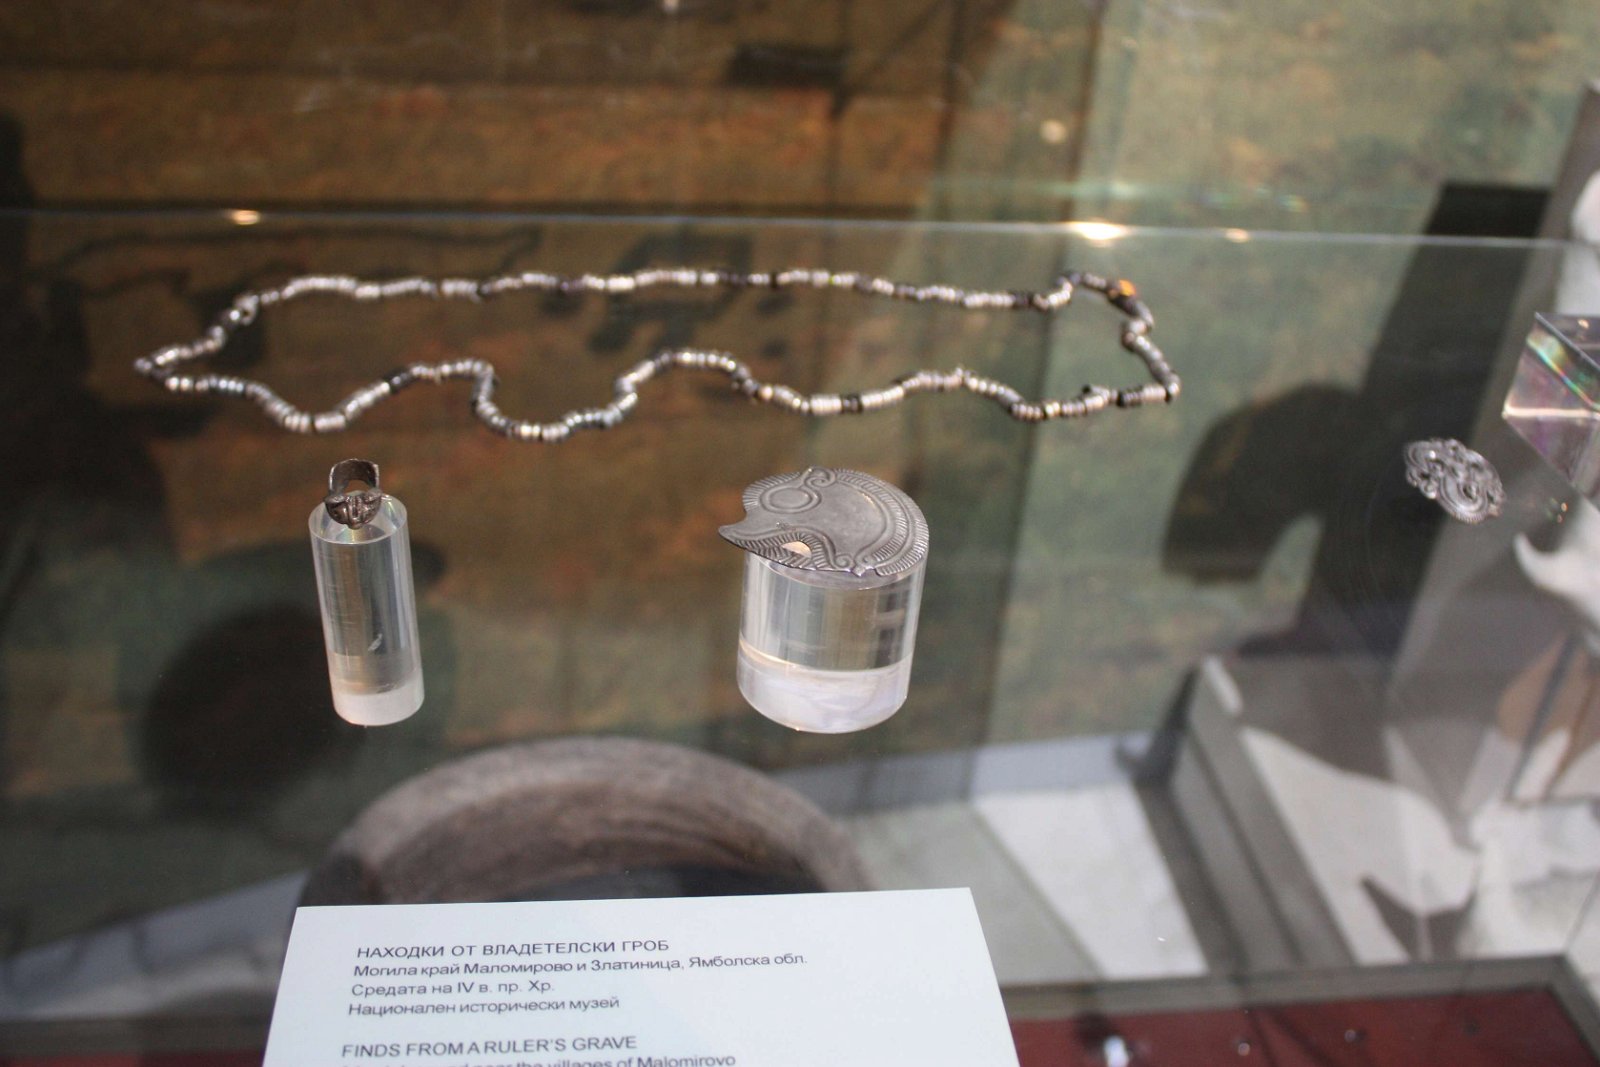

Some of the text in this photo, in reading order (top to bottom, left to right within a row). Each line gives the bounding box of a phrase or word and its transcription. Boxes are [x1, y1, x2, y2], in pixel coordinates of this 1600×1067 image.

[356, 939, 670, 960] НАХОДКИ ОТ ВЛАДЕТЕЛСКИ ГРОБ
[353, 953, 807, 978] Могила край Маломирово и Златиница, Ямболска обл.
[351, 980, 555, 998] Средата на IV в. пр. Хр.
[348, 996, 620, 1017] Национален исторически музей
[341, 1043, 401, 1058] FINDS
[405, 1042, 464, 1056] FROM
[466, 1041, 481, 1055] A
[572, 1036, 637, 1051] GRAVE
[637, 1056, 736, 1067] Malomirovo
